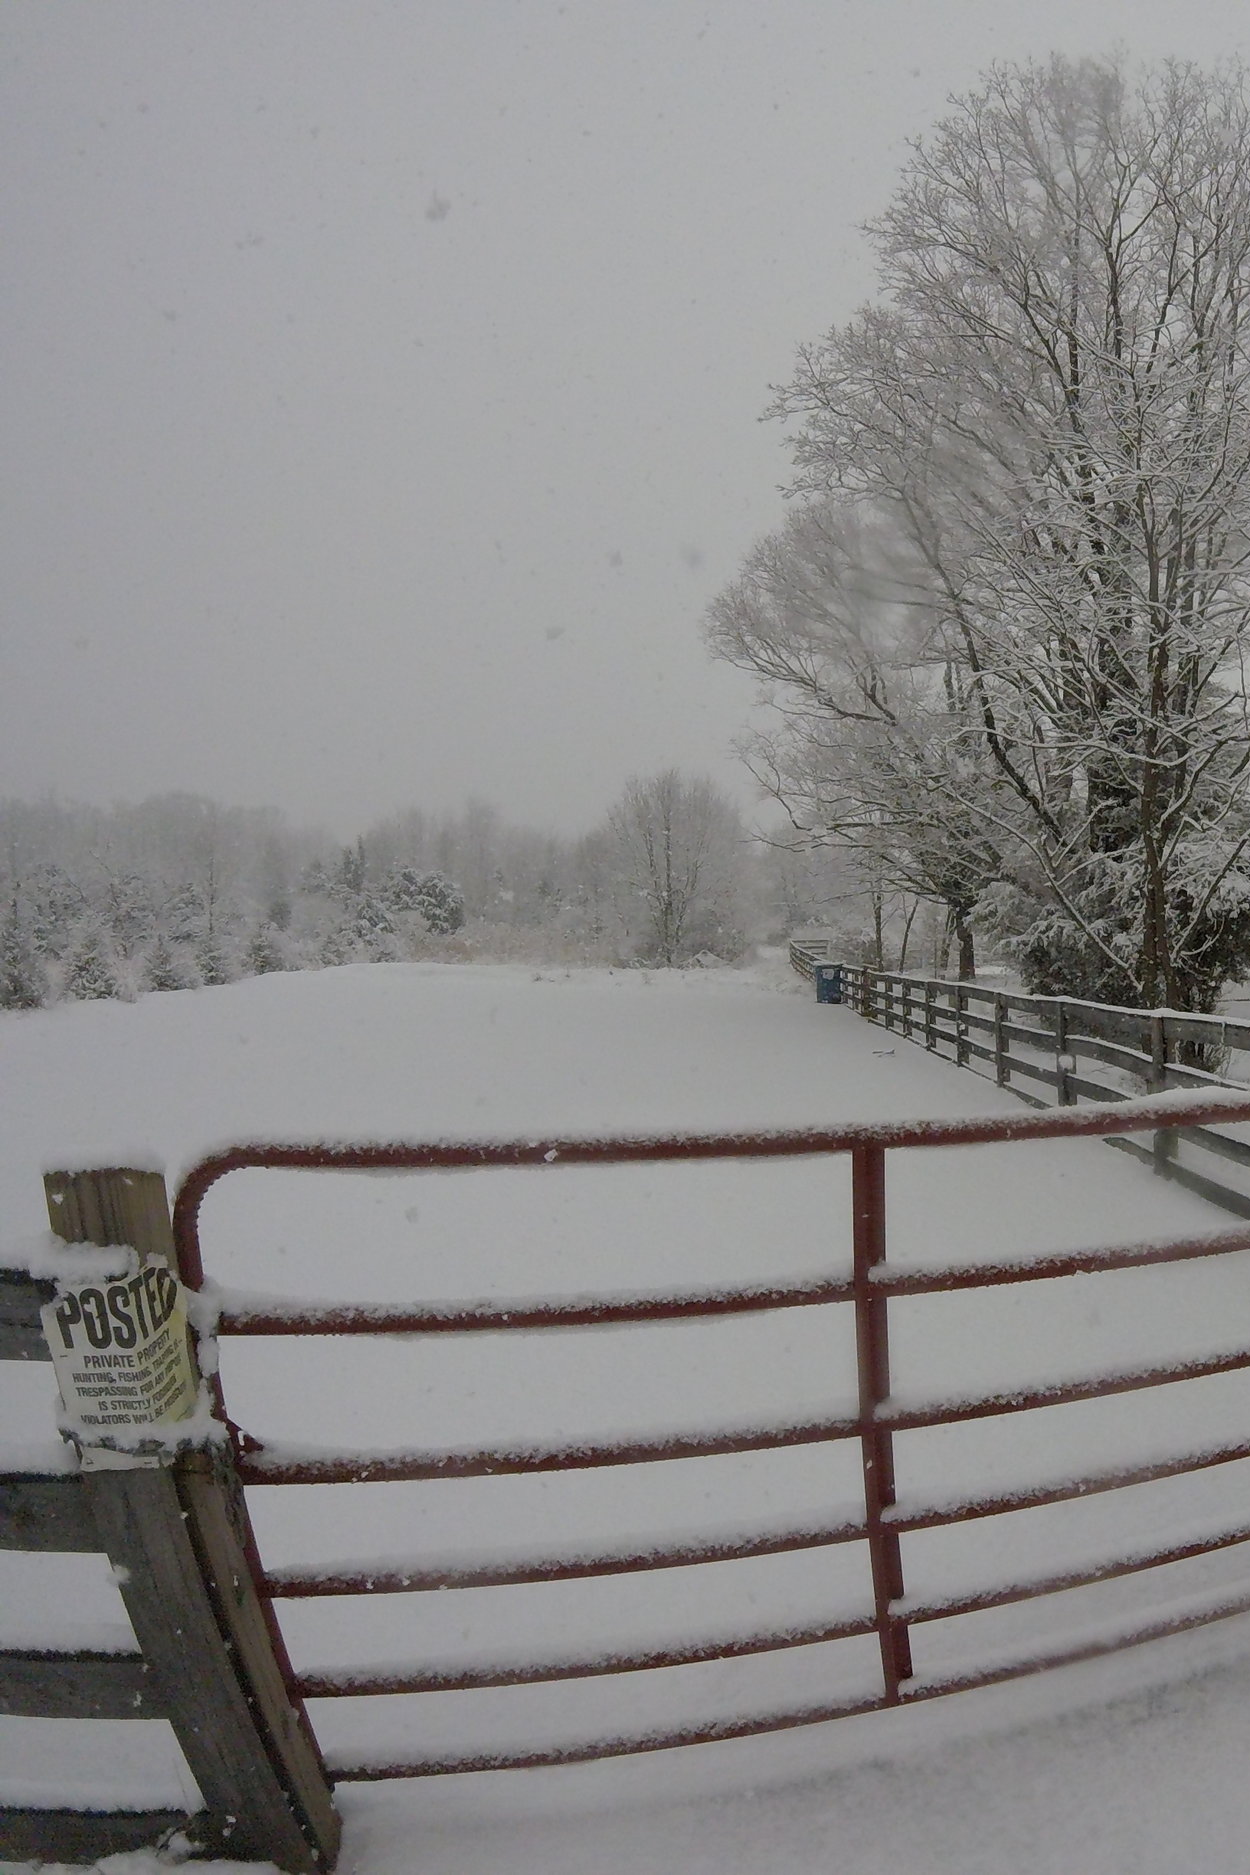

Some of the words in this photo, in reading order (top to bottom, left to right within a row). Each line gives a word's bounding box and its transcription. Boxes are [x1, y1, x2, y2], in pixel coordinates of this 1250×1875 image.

[56, 1267, 178, 1350] POSTED
[83, 1354, 136, 1369] PRIVATE
[136, 1327, 170, 1366] PROPERTY
[75, 1386, 138, 1398] TRESPASSING
[139, 1380, 155, 1396] FOR
[98, 1400, 109, 1411] IS
[110, 1396, 151, 1411] STRICTLY
[81, 1413, 132, 1425] VIOLATORS
[154, 1404, 164, 1419] BE
